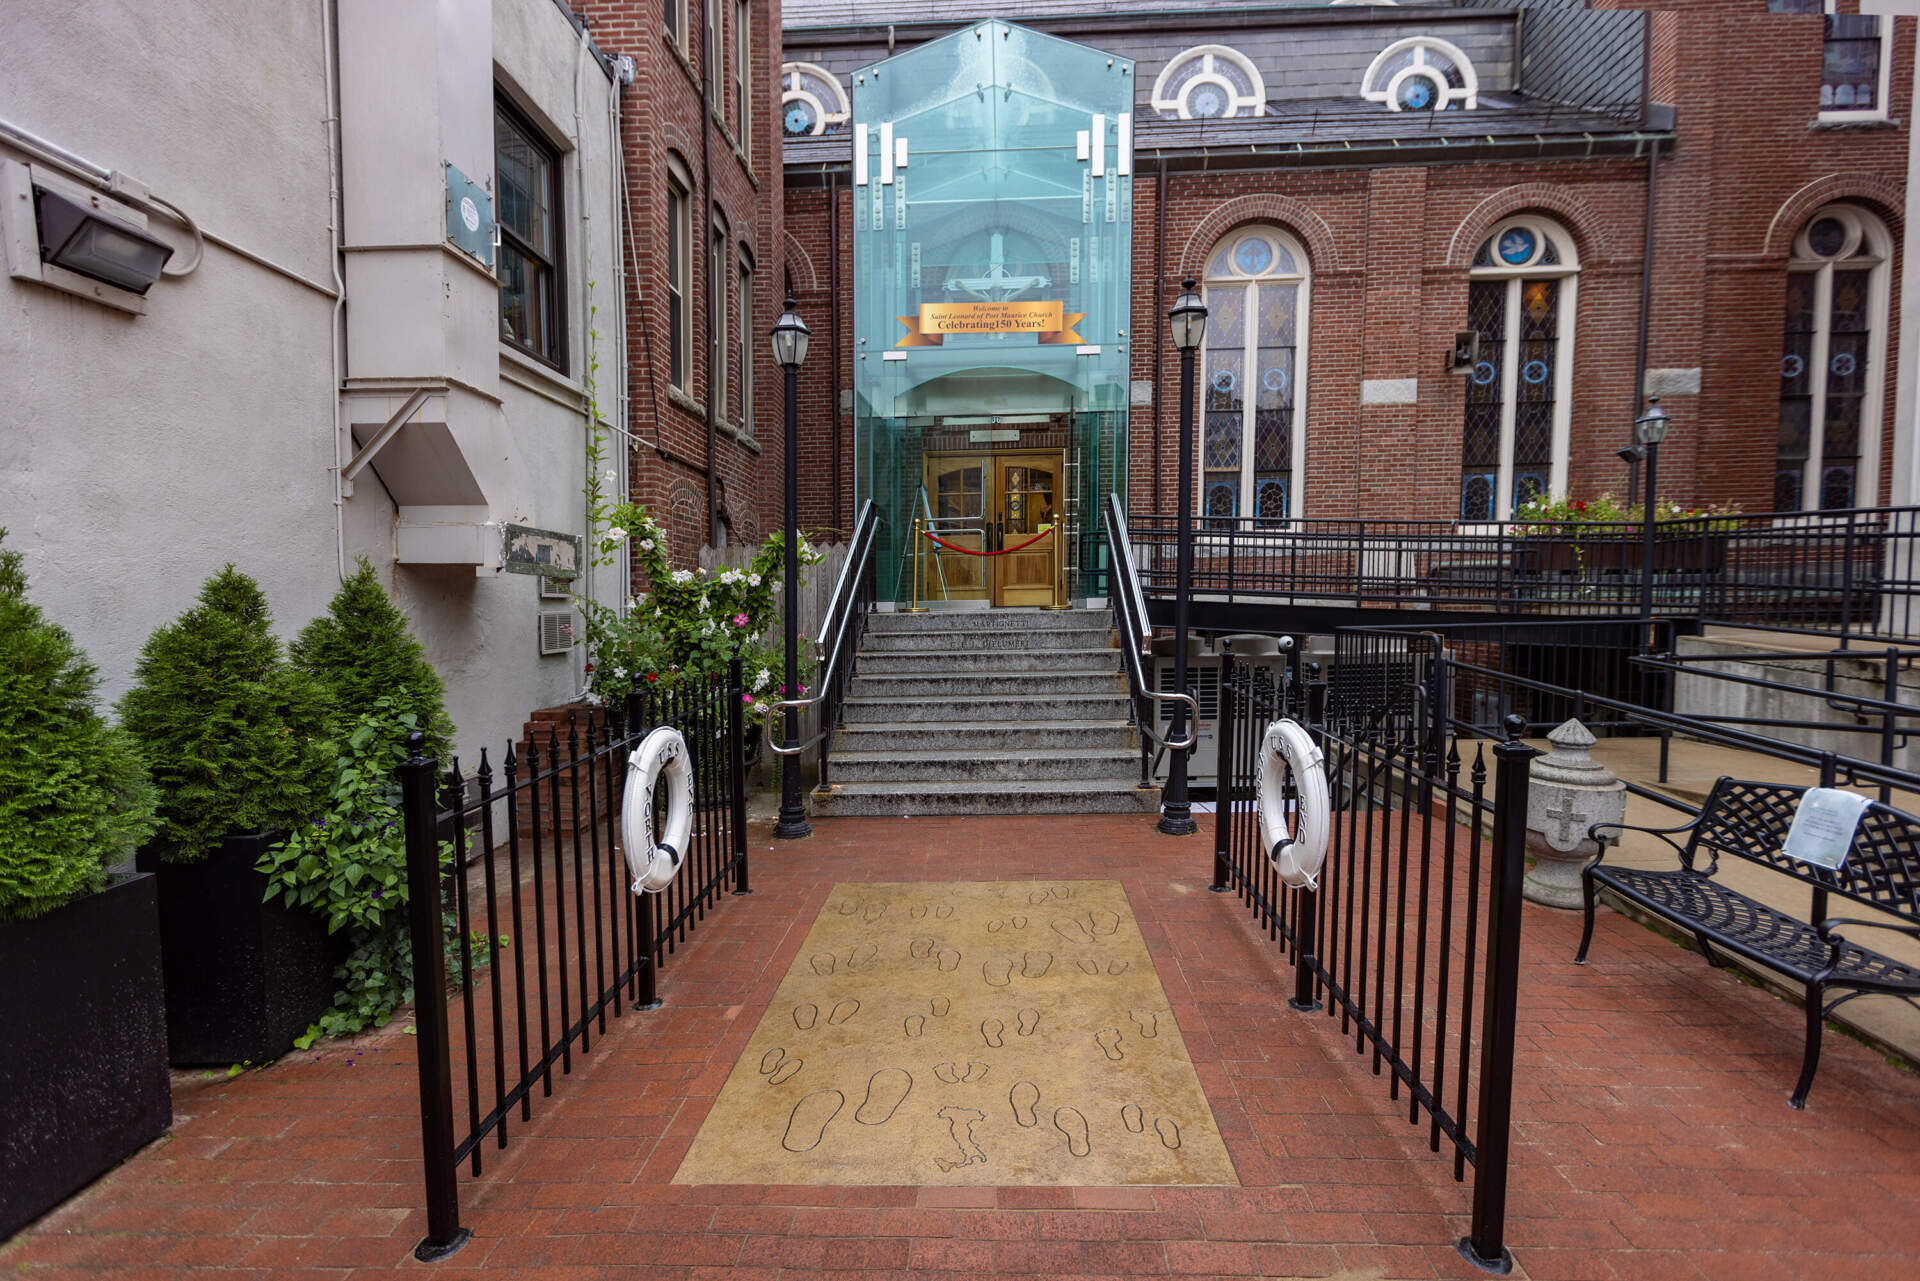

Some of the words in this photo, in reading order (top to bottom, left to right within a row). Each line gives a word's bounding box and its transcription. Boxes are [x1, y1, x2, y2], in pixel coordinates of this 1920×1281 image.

[976, 312, 984, 320] of
[1014, 319, 1045, 328] Years!
[659, 743, 680, 764] USS
[1270, 736, 1292, 759] USS
[644, 784, 655, 865] NORTH
